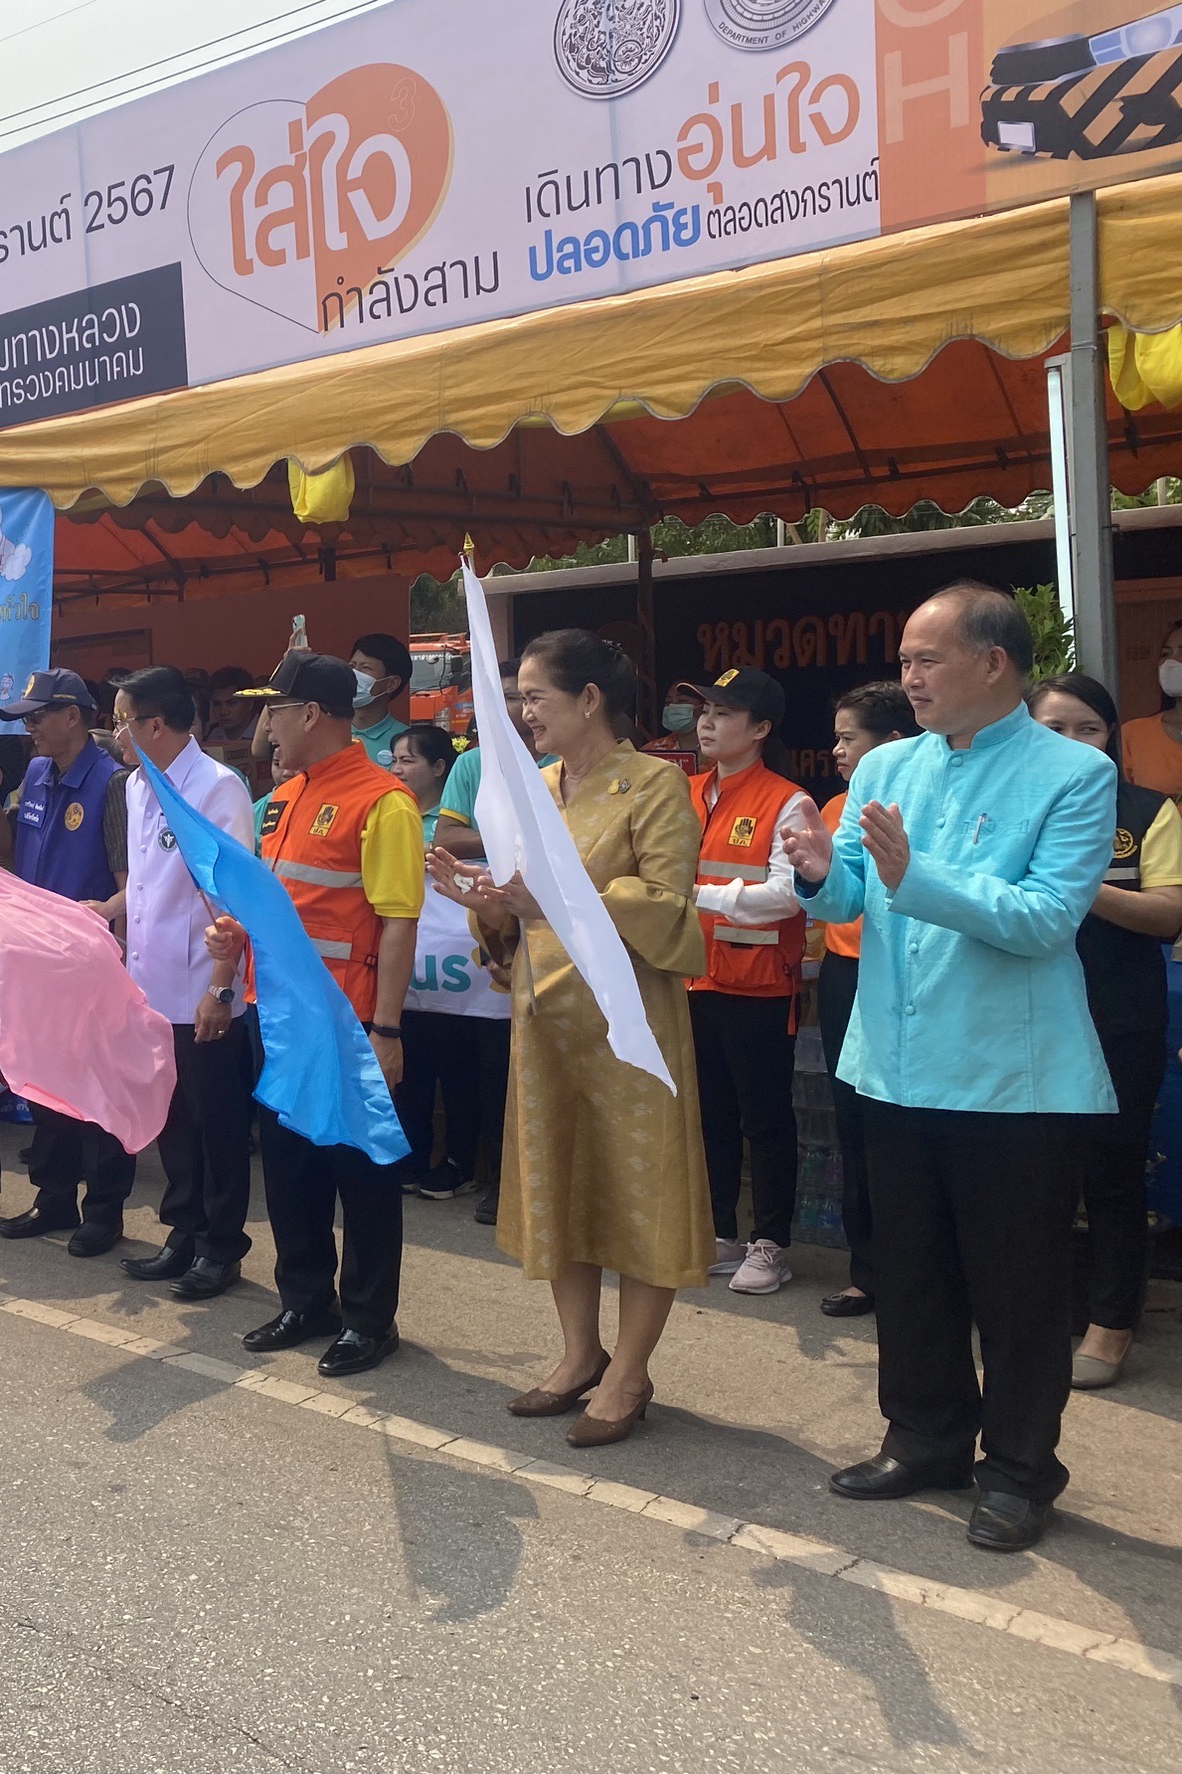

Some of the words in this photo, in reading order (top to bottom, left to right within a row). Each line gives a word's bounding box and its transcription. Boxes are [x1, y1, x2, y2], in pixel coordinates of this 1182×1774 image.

[718, 21, 769, 45] DEPARTMENT
[775, 30, 787, 41] OF
[525, 147, 675, 224] เดินทาง
[676, 60, 861, 205] อุ่นใจ
[84, 164, 177, 235] 2567
[216, 113, 414, 277] ใส่ใจ
[528, 200, 702, 281] ปลอดภัย
[706, 157, 880, 240] ตลอดสงกรานต์
[320, 250, 501, 333] กำลังสาม
[698, 611, 904, 672] หมวดทา
